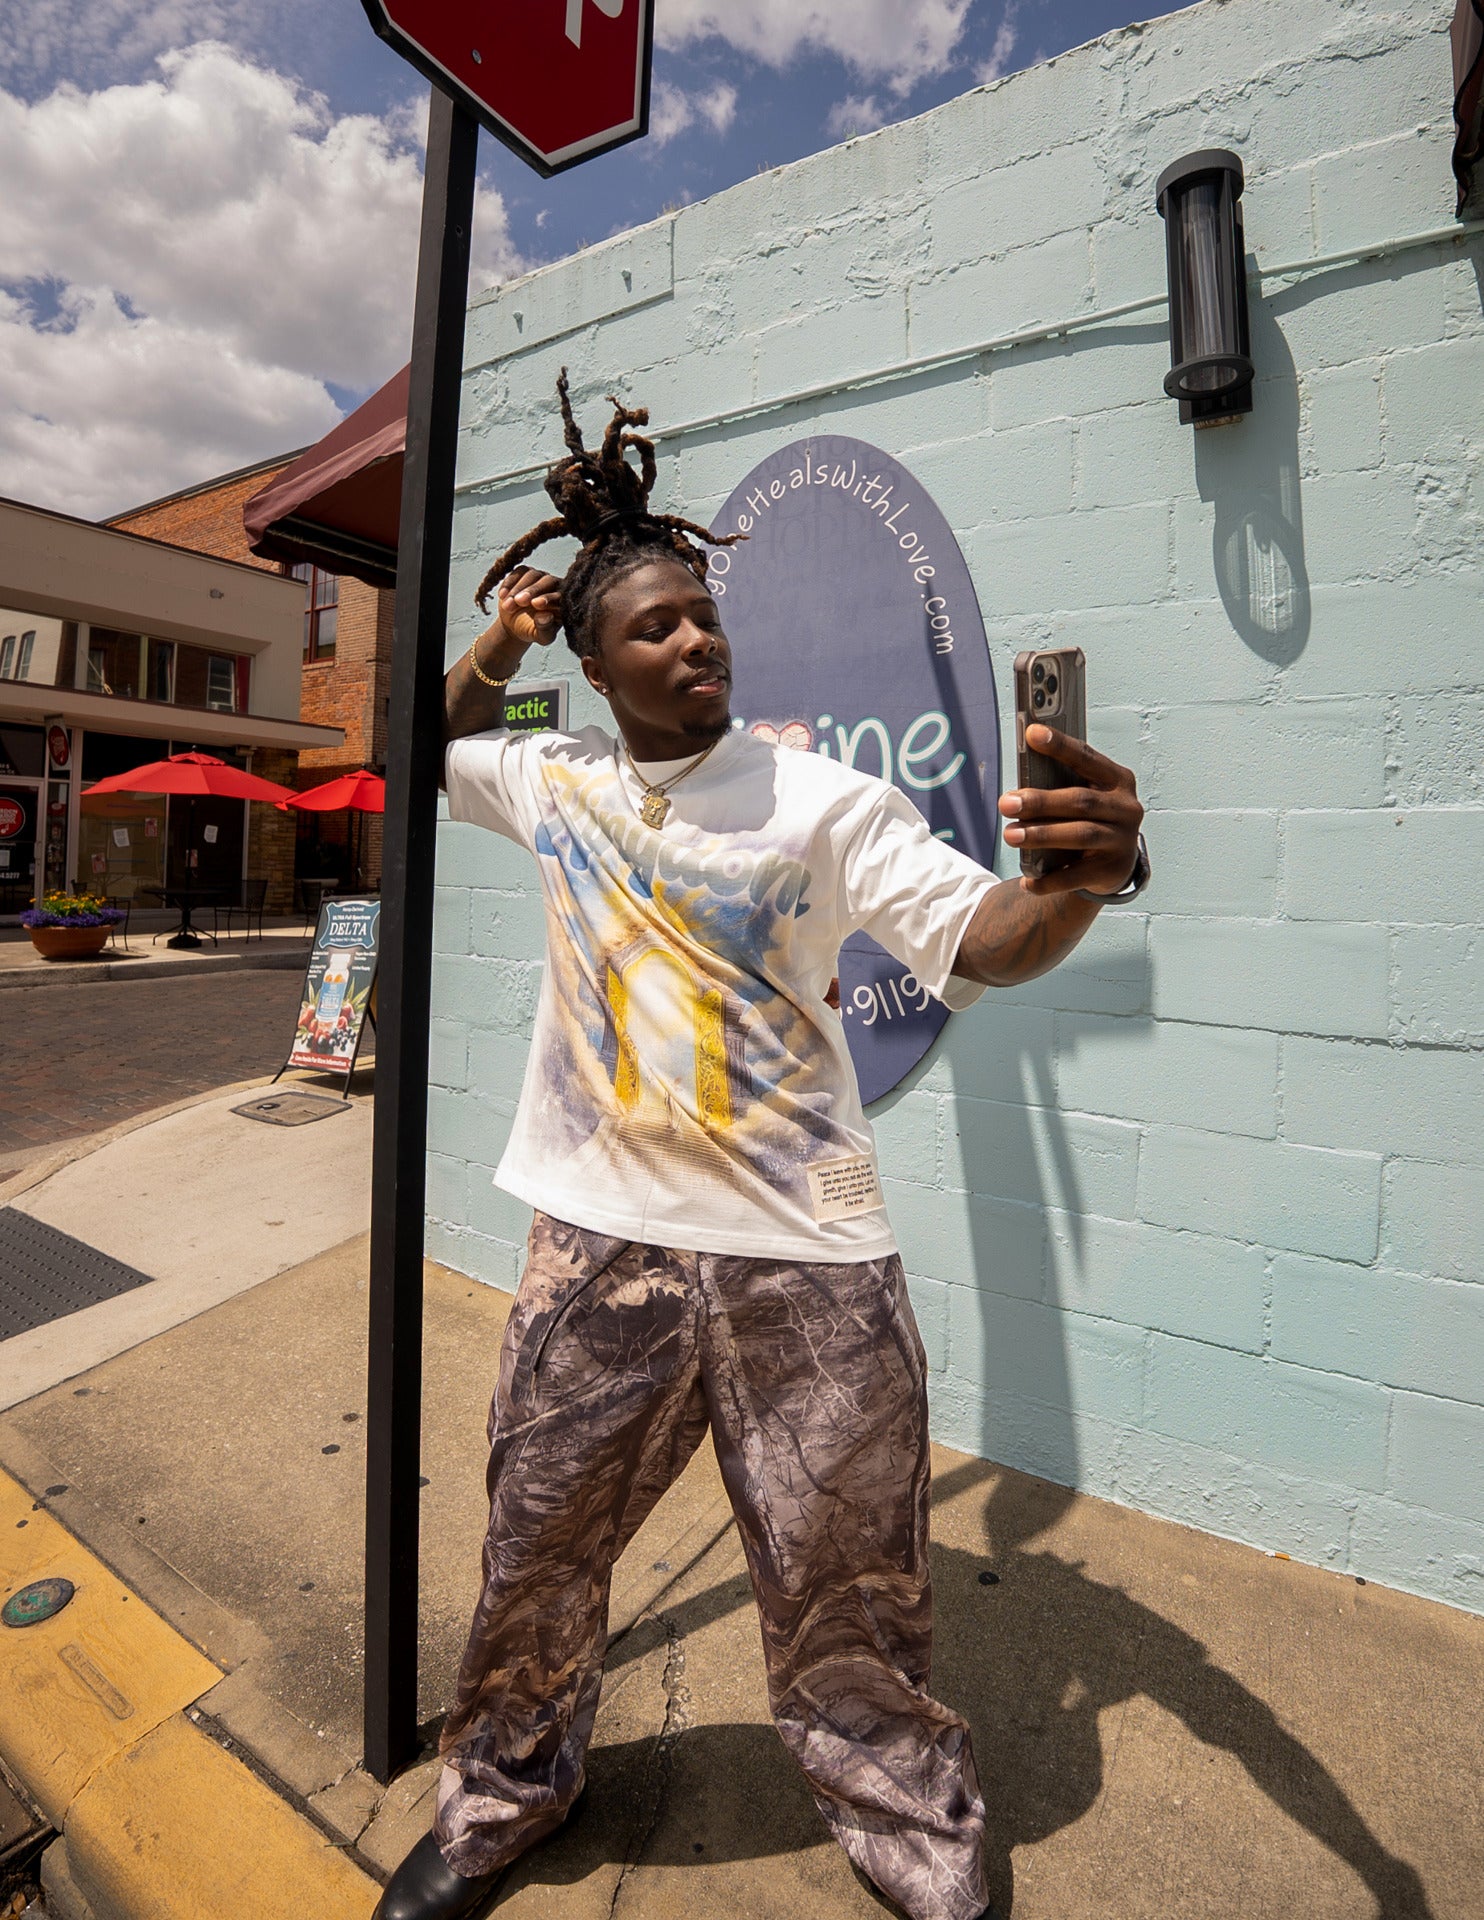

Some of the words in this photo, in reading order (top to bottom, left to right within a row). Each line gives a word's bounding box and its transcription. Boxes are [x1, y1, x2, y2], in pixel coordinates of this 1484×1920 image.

[504, 696, 549, 721] actic
[329, 922, 367, 936] DELTA
[840, 973, 930, 1026] .9119
